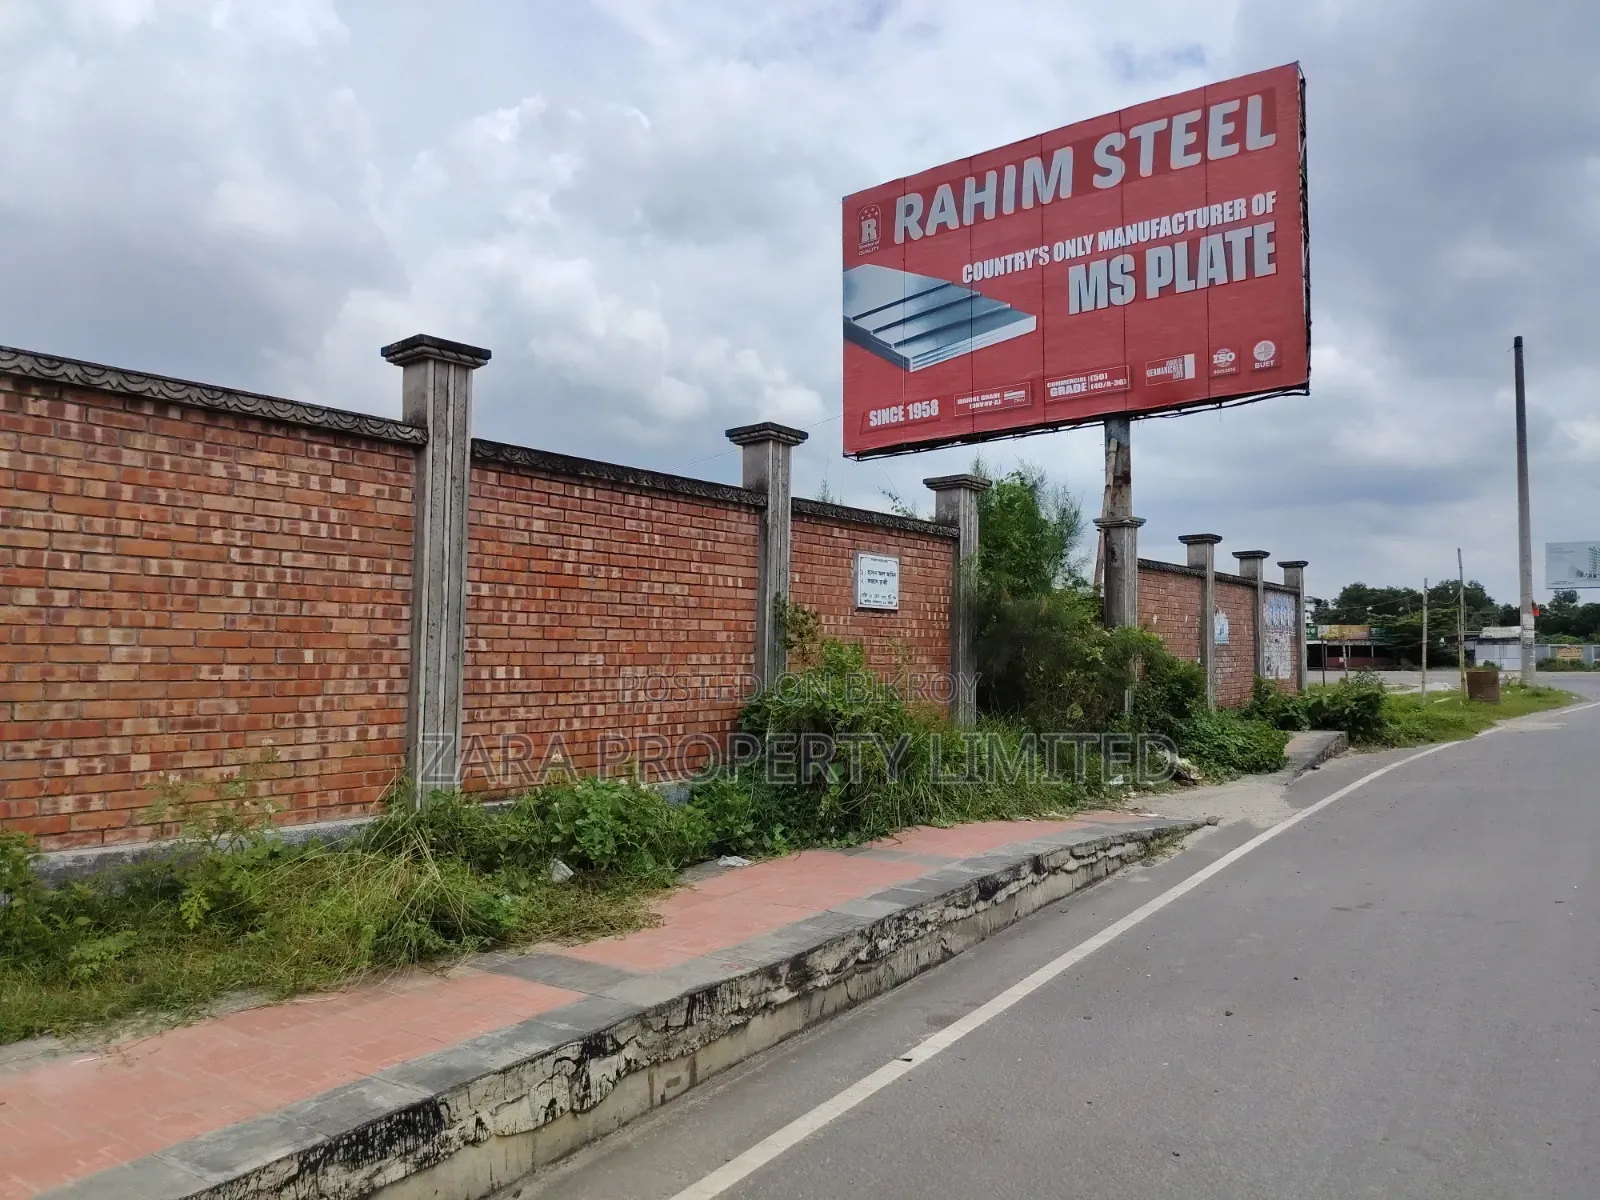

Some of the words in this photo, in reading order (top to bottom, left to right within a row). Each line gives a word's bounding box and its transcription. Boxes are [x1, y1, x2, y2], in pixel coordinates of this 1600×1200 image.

[893, 146, 1074, 244] RAHIM
[1092, 94, 1277, 189] STEEL
[861, 218, 877, 243] R
[962, 246, 1050, 285] COUNTRY'S
[1053, 233, 1095, 262] ONLY
[1098, 197, 1247, 252] MANUFACTURER
[1251, 190, 1277, 216] OF
[1068, 253, 1136, 316] MS
[1146, 221, 1277, 300] PLATE
[1212, 352, 1236, 364] ISO
[1254, 360, 1275, 369] BUET
[1047, 376, 1087, 388] COMMERCIAL
[1050, 382, 1088, 397] GRADE
[869, 405, 905, 427] SINCE
[907, 398, 939, 420] 1958
